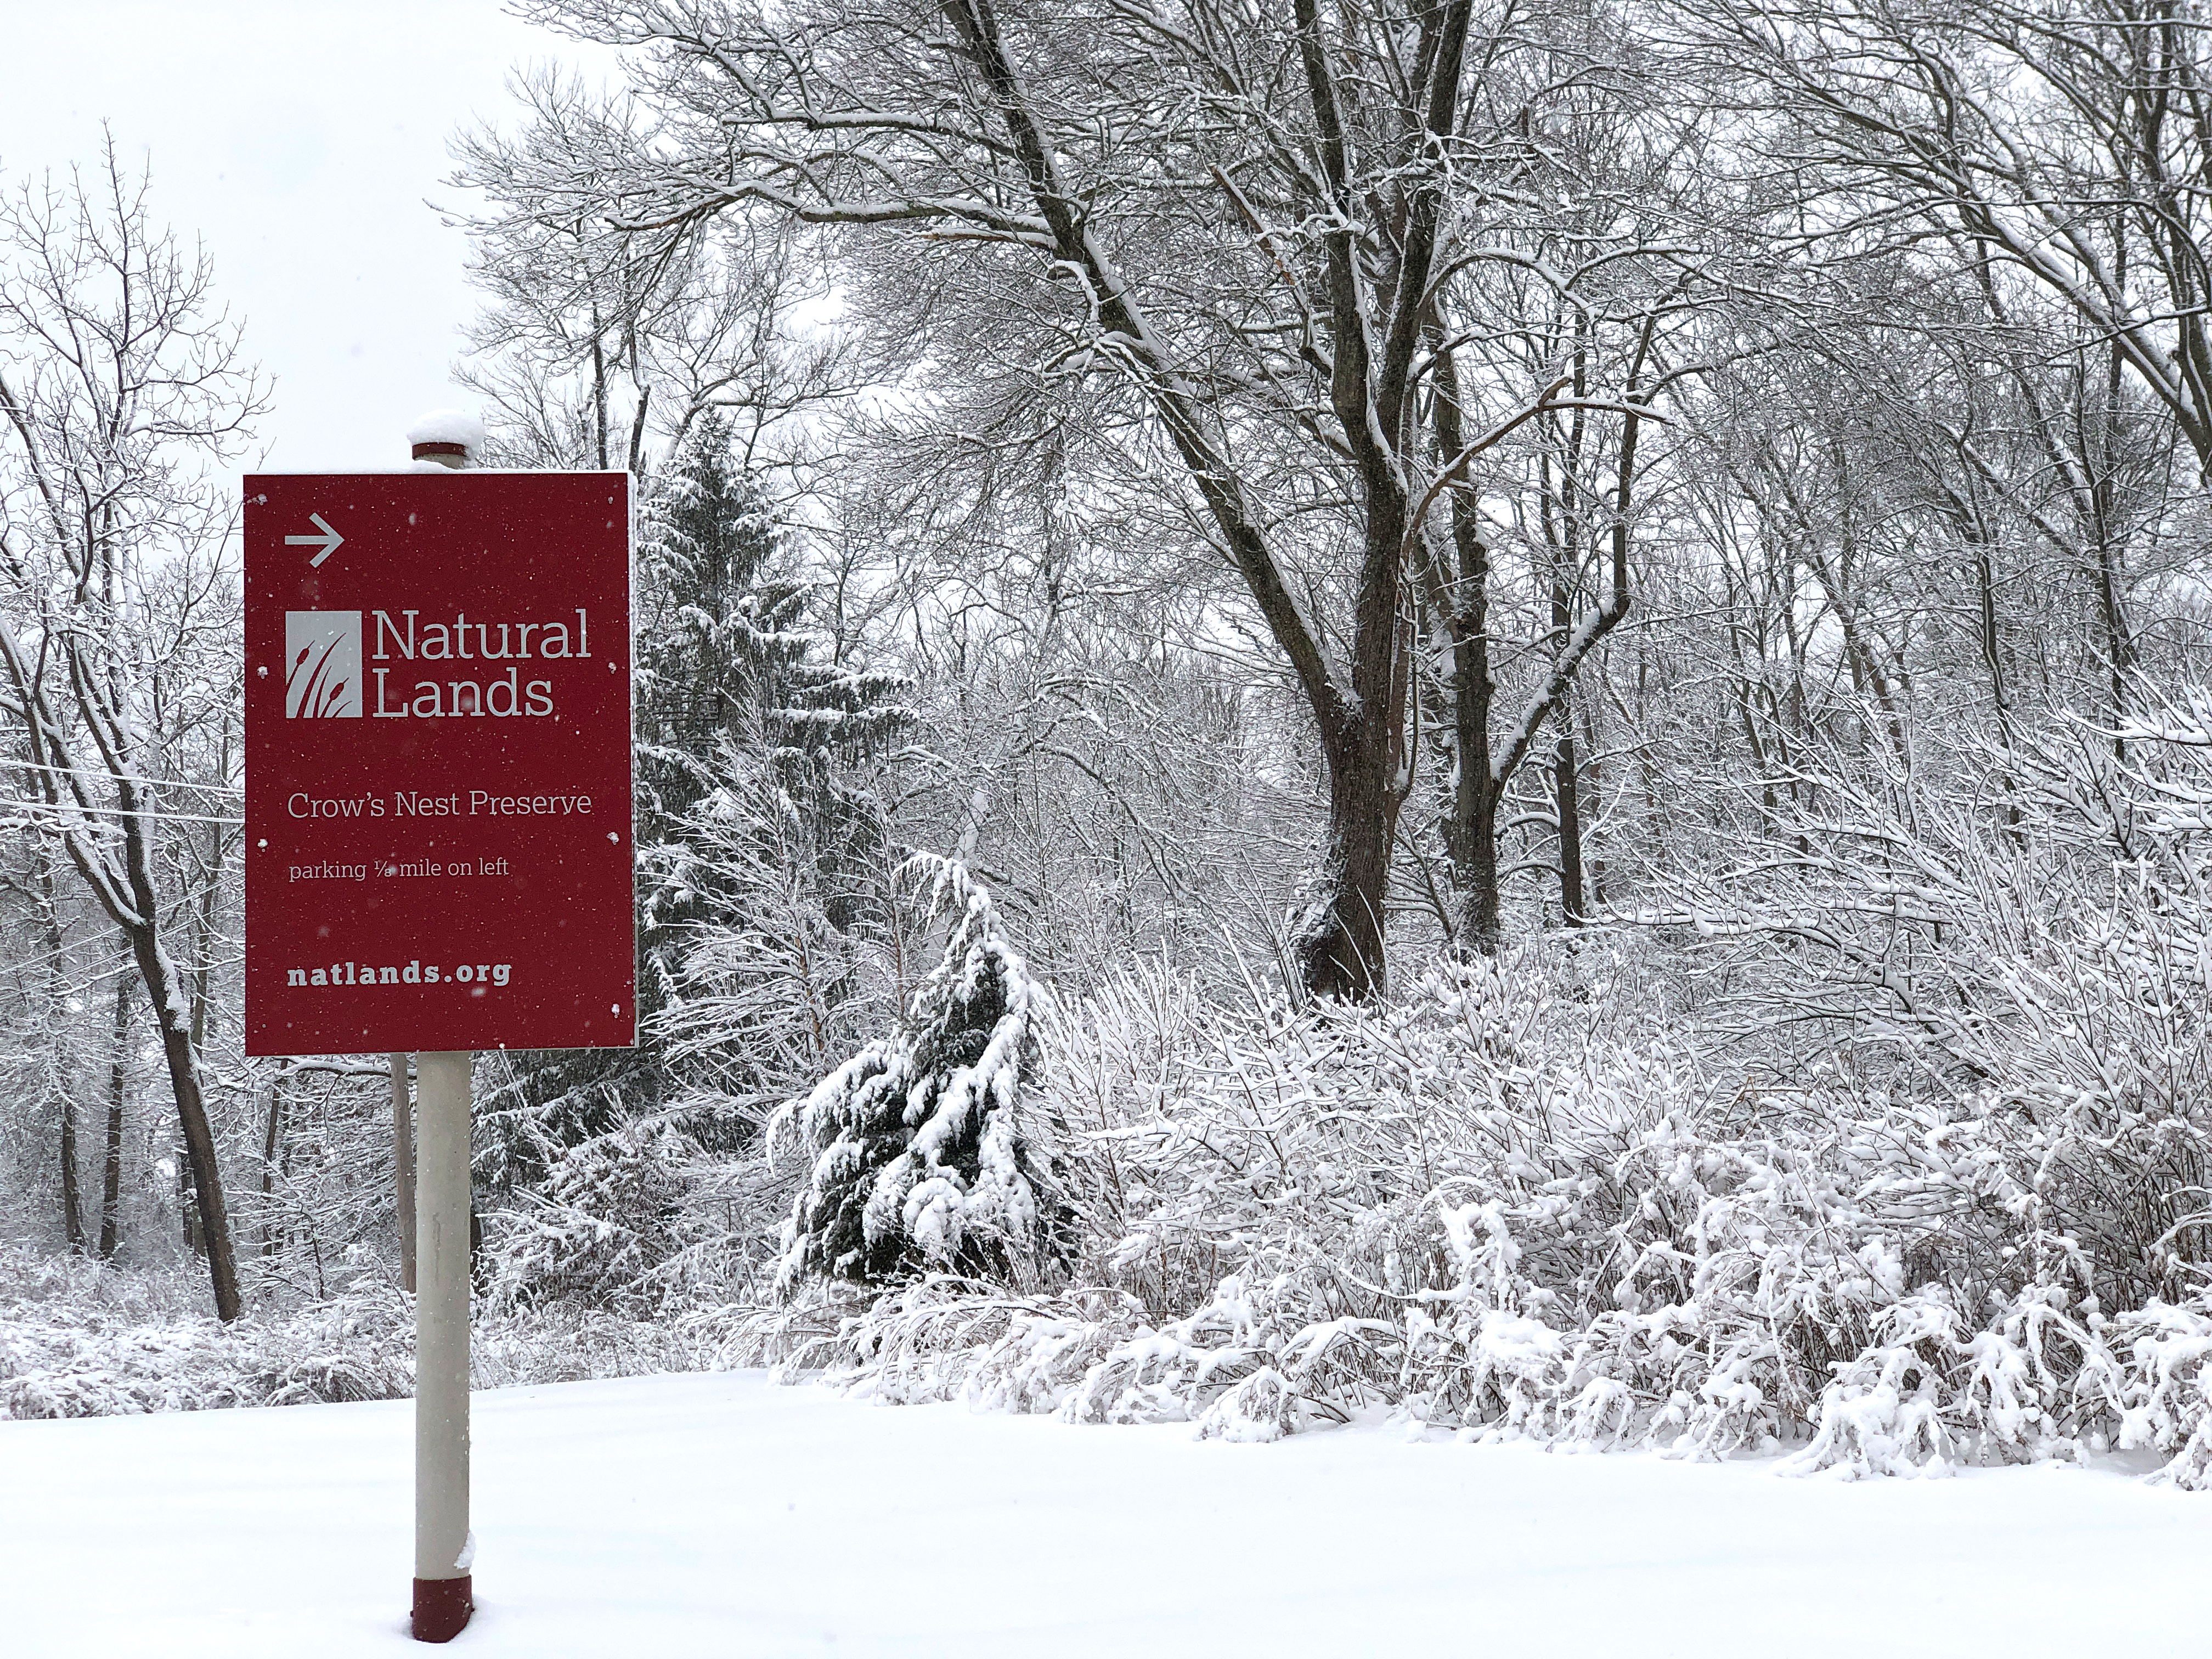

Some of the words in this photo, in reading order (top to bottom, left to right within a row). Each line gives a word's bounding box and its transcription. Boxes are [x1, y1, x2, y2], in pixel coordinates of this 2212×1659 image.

[371, 608, 592, 660] Natural
[372, 667, 554, 718] Lands
[394, 791, 461, 817] Nest
[469, 790, 592, 815] Preserve
[289, 860, 368, 883] parking
[399, 858, 442, 877] mile
[448, 862, 473, 876] on
[478, 856, 510, 876] left
[287, 960, 512, 987] natlands.org
